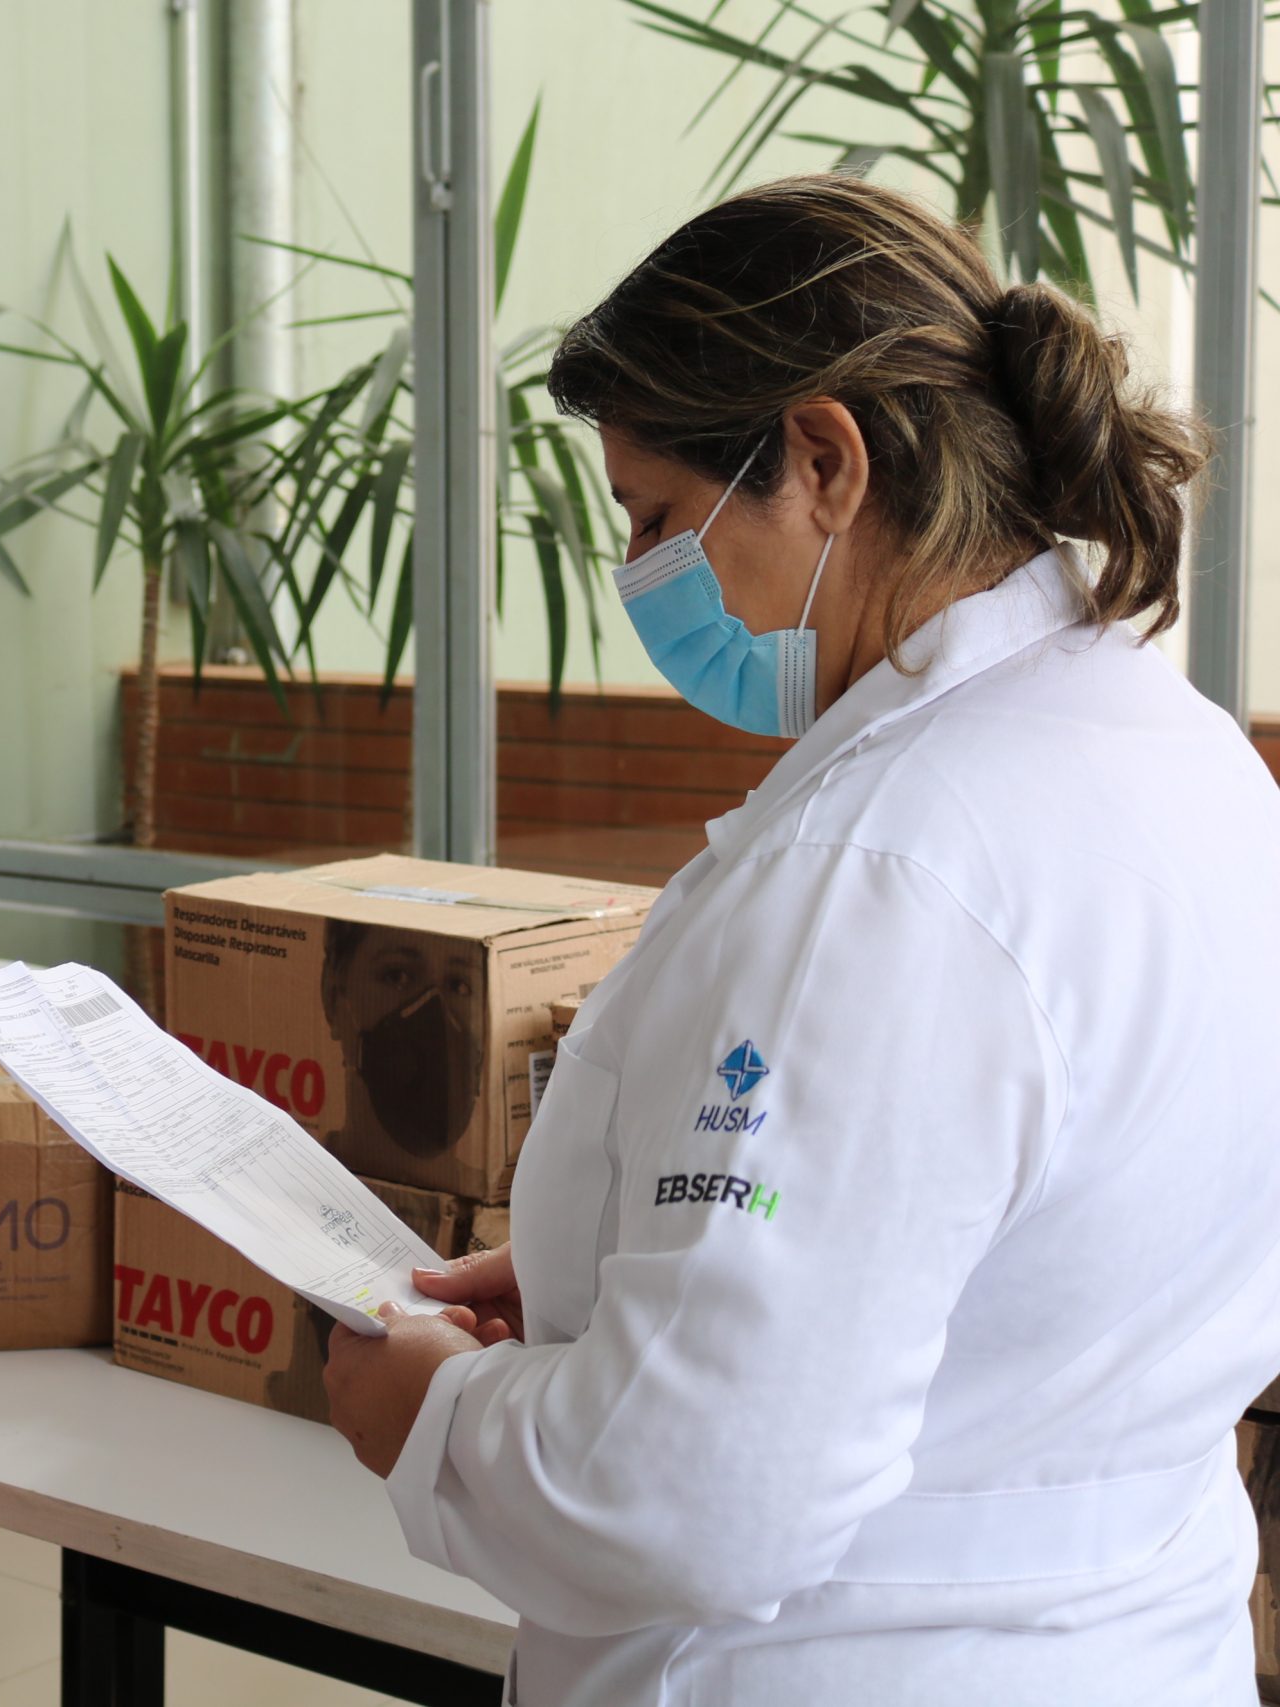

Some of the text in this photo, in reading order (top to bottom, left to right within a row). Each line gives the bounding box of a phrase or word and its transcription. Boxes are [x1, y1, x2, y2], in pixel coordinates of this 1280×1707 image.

[173, 907, 308, 942] Respiradores Descartáveis
[174, 926, 288, 959] Disposable Respirators
[174, 945, 220, 967] Mascarilla
[694, 1105, 768, 1135] HUSM
[654, 1173, 781, 1221] EBSERH
[114, 1264, 274, 1355] TAYCO
